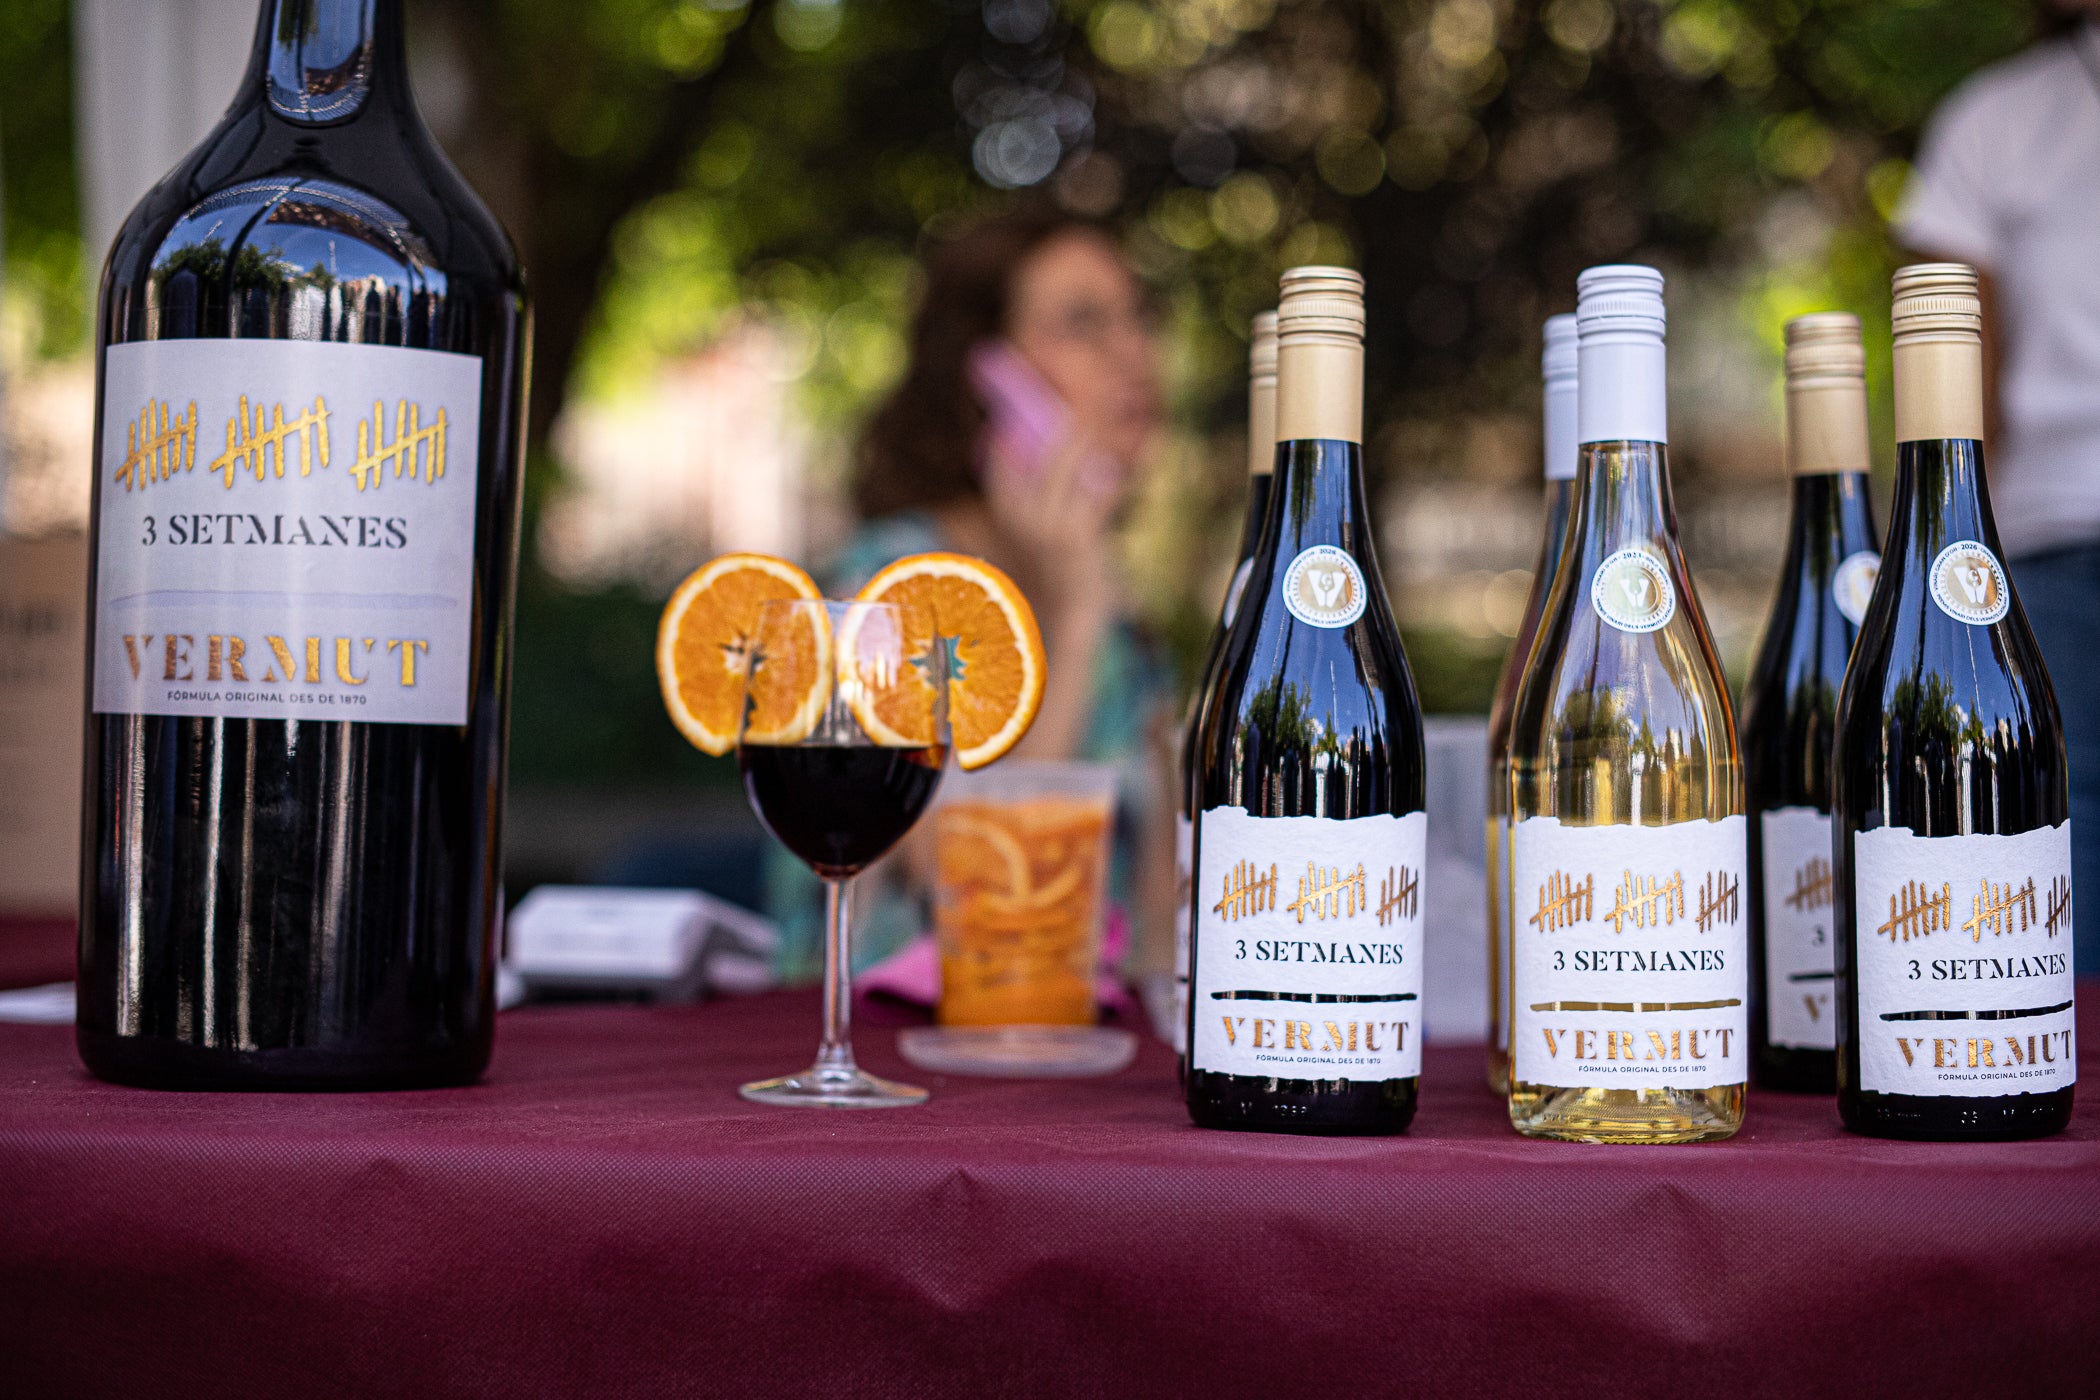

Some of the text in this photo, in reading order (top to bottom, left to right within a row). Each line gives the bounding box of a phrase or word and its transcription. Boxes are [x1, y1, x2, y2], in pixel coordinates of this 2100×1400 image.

[142, 514, 408, 549] 3 SETMANES
[123, 634, 429, 686] VERMUT
[167, 690, 367, 705] FÓRMULA ORIGINAL DES DE 1870
[1235, 939, 1404, 966] 3 SETMANES
[1553, 950, 1725, 972] 3 SETMANES
[1908, 953, 2067, 981] 3 SETMANES
[1222, 1016, 1410, 1053] VERMUT
[1542, 1028, 1735, 1061] VERMUT
[1256, 1054, 1295, 1062] FÓRMULA
[1896, 1029, 2072, 1069] VERMUT
[1578, 1065, 1618, 1073] FÓRMULA
[1980, 1072, 2018, 1080] ORIGINAL
